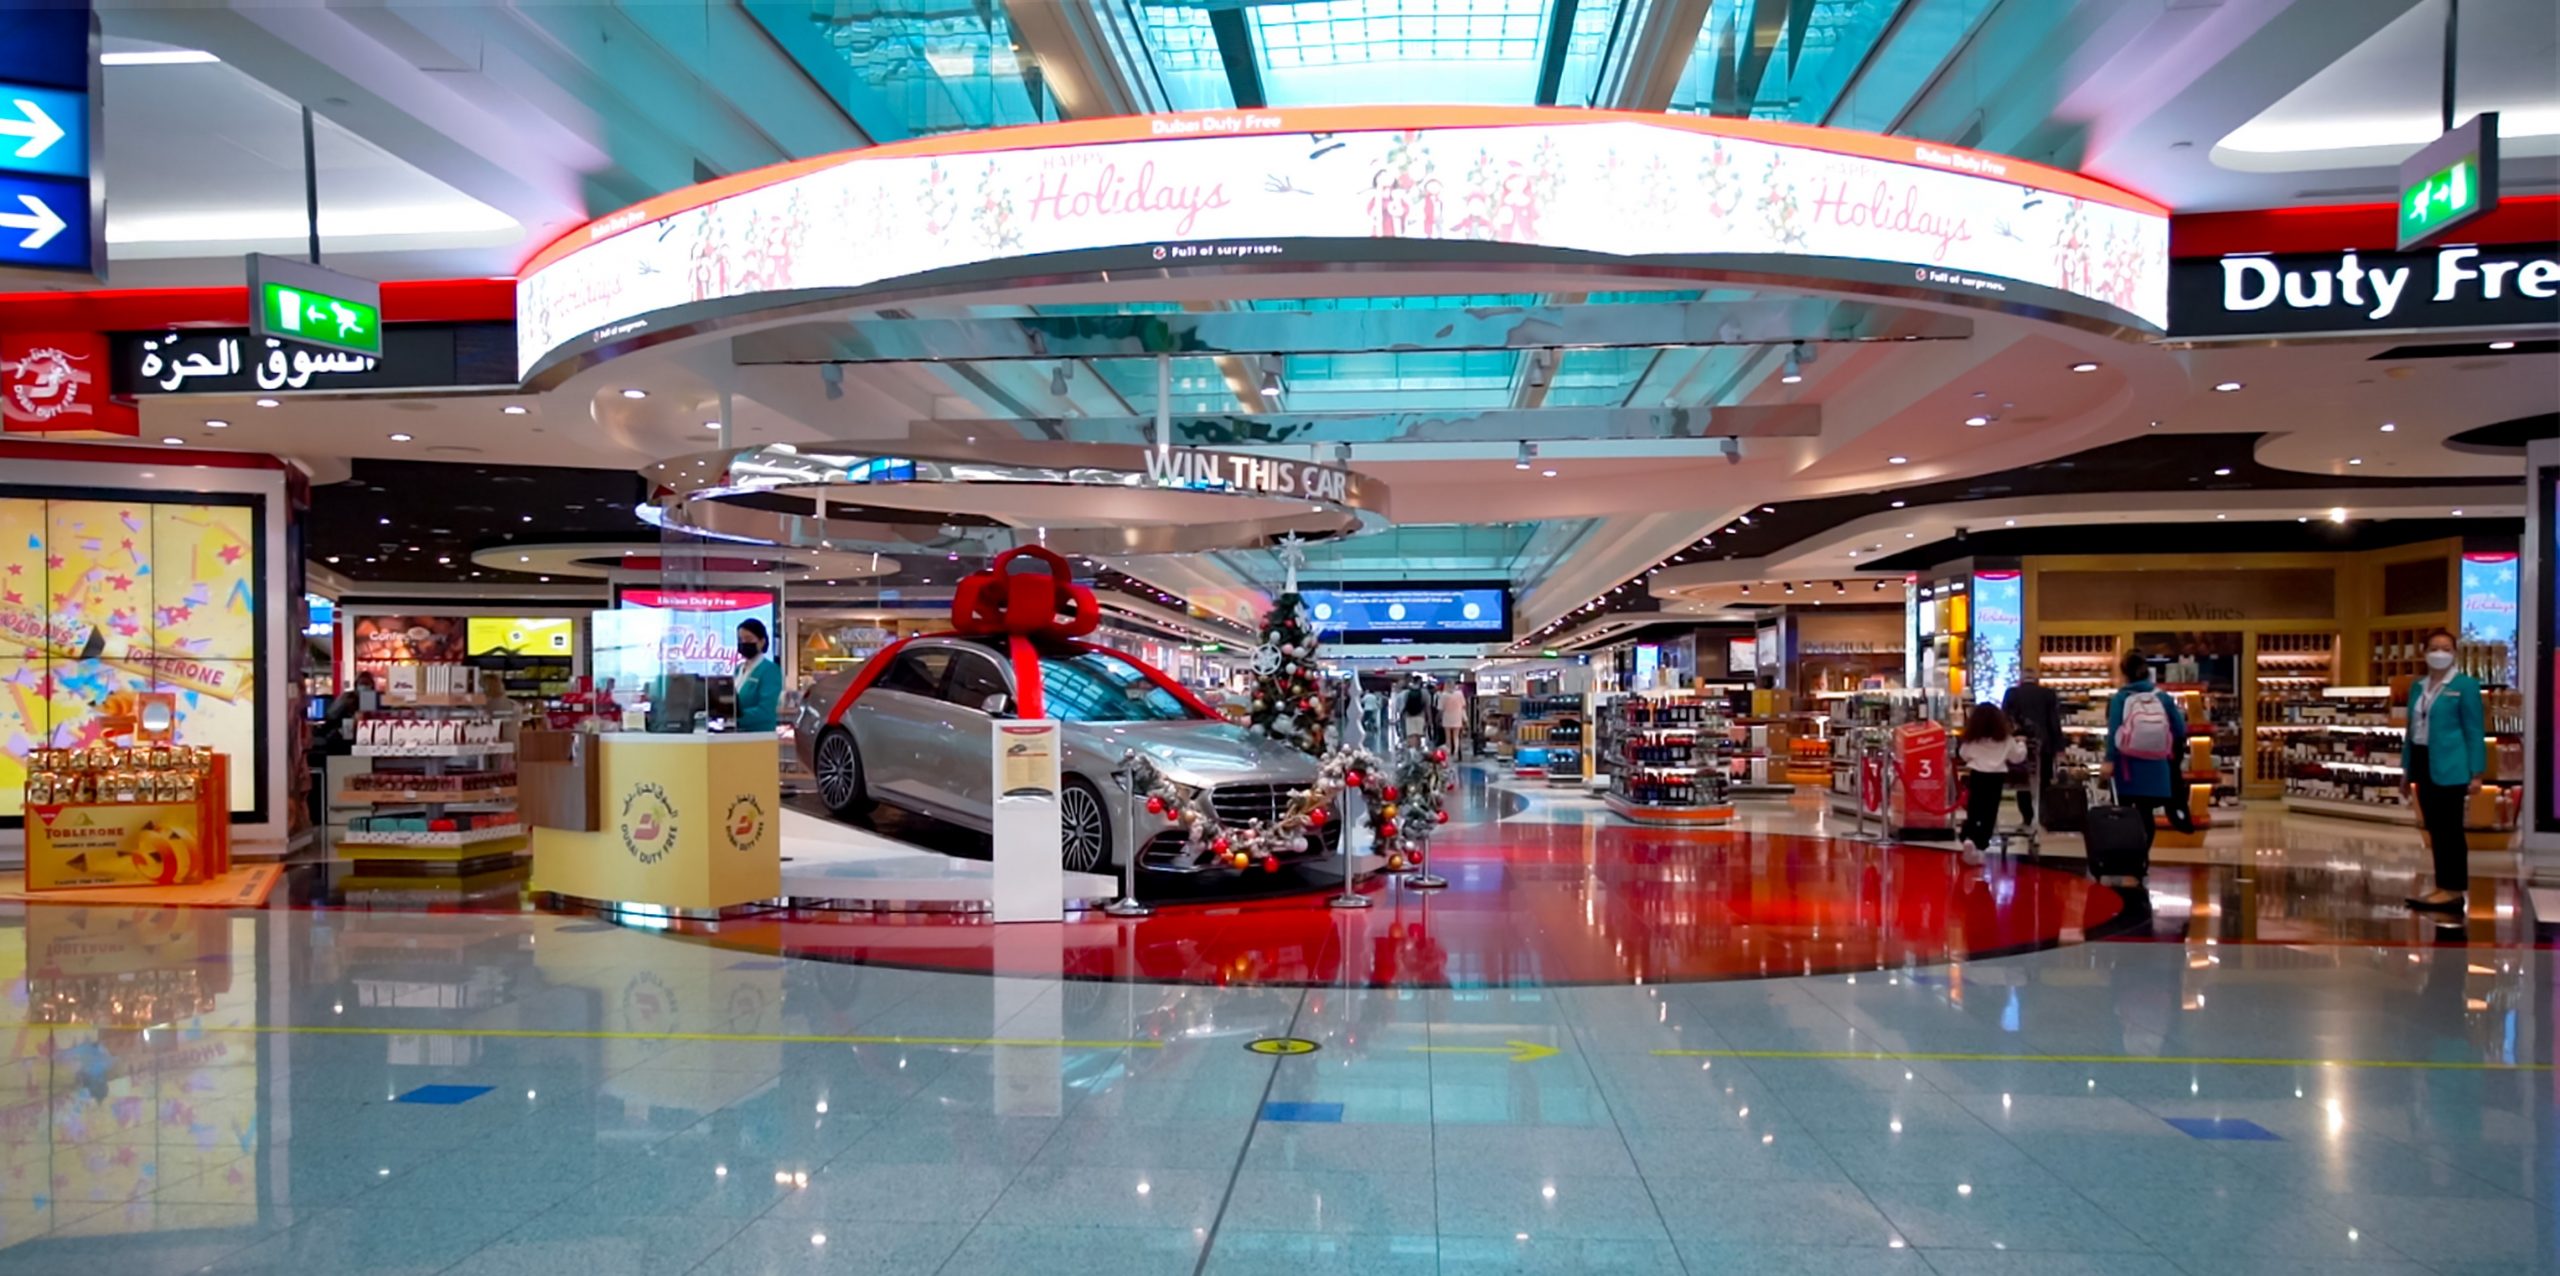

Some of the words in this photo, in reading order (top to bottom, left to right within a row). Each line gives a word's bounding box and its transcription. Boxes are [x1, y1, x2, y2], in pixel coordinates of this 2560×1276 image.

[1202, 117, 1241, 134] Duty
[1245, 115, 1282, 130] Free
[1028, 160, 1232, 237] Holidays
[1812, 180, 1972, 262] Holidays
[1172, 246, 1198, 257] Full
[1199, 245, 1214, 257] of
[2220, 254, 2410, 320] Duty
[36, 403, 62, 418] DUTY
[1144, 450, 1219, 485] WIN
[1228, 456, 1296, 494] THIS
[1301, 466, 1347, 501] CAR
[2133, 601, 2177, 621] Fine
[2181, 601, 2246, 621] Wines
[124, 644, 225, 687] TOBLERONE
[1918, 759, 1932, 778] 3
[44, 827, 125, 840] TOBLERONE
[620, 823, 638, 858] DUBAI
[639, 851, 664, 865] DUTY
[662, 824, 679, 855] FREE
